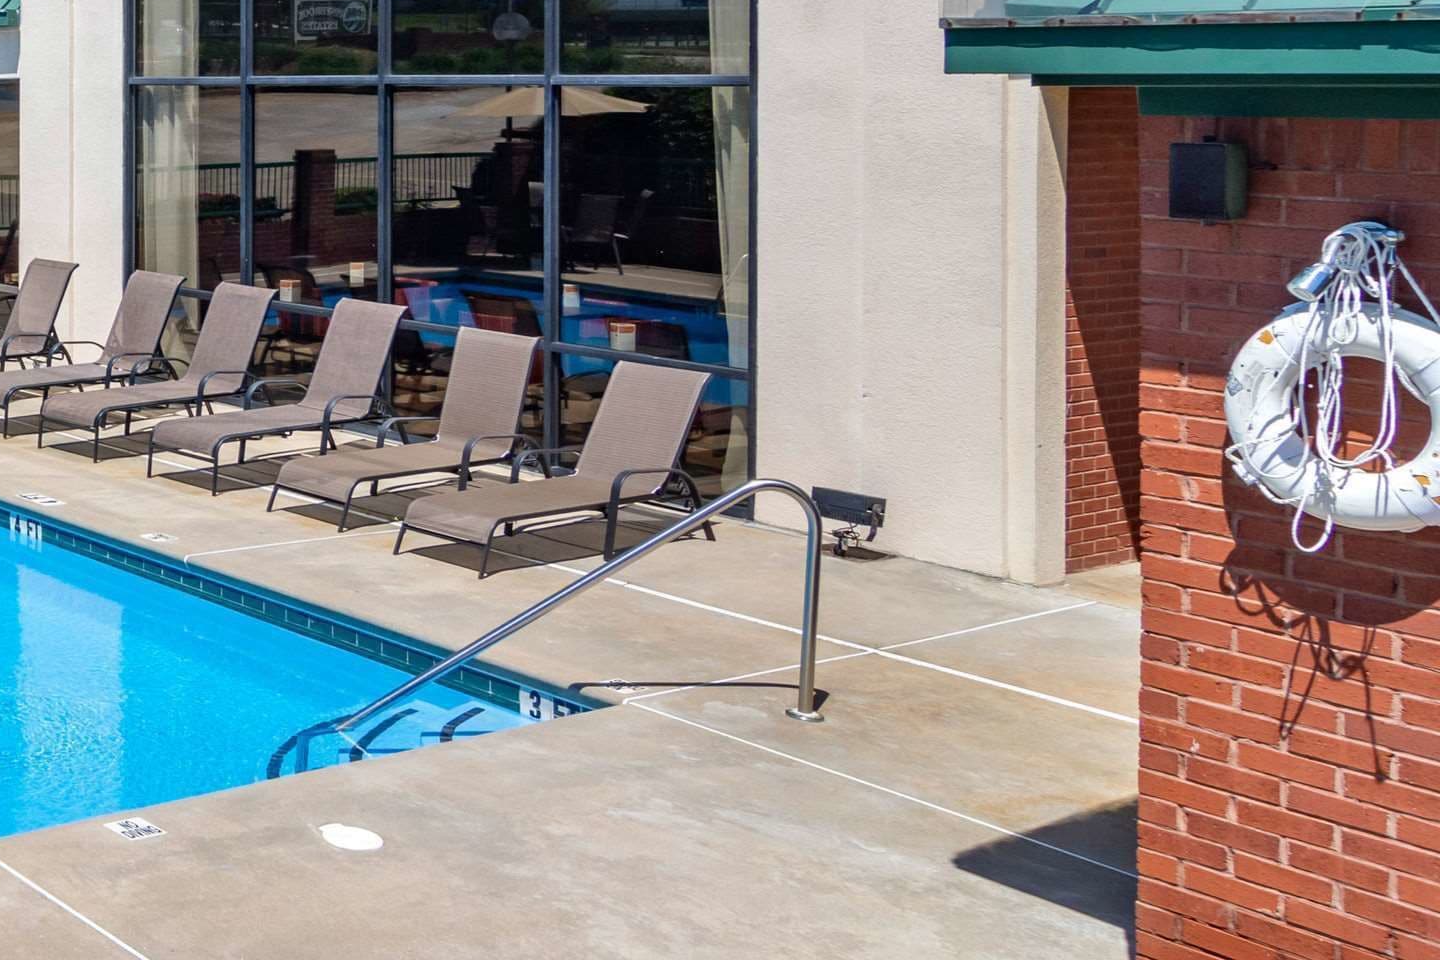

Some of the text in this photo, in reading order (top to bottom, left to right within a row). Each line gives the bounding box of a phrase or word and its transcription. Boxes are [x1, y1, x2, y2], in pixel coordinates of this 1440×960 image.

[14, 514, 22, 533] 4
[529, 690, 541, 719] 3
[118, 820, 140, 830] NO
[121, 825, 162, 839] DIVING
